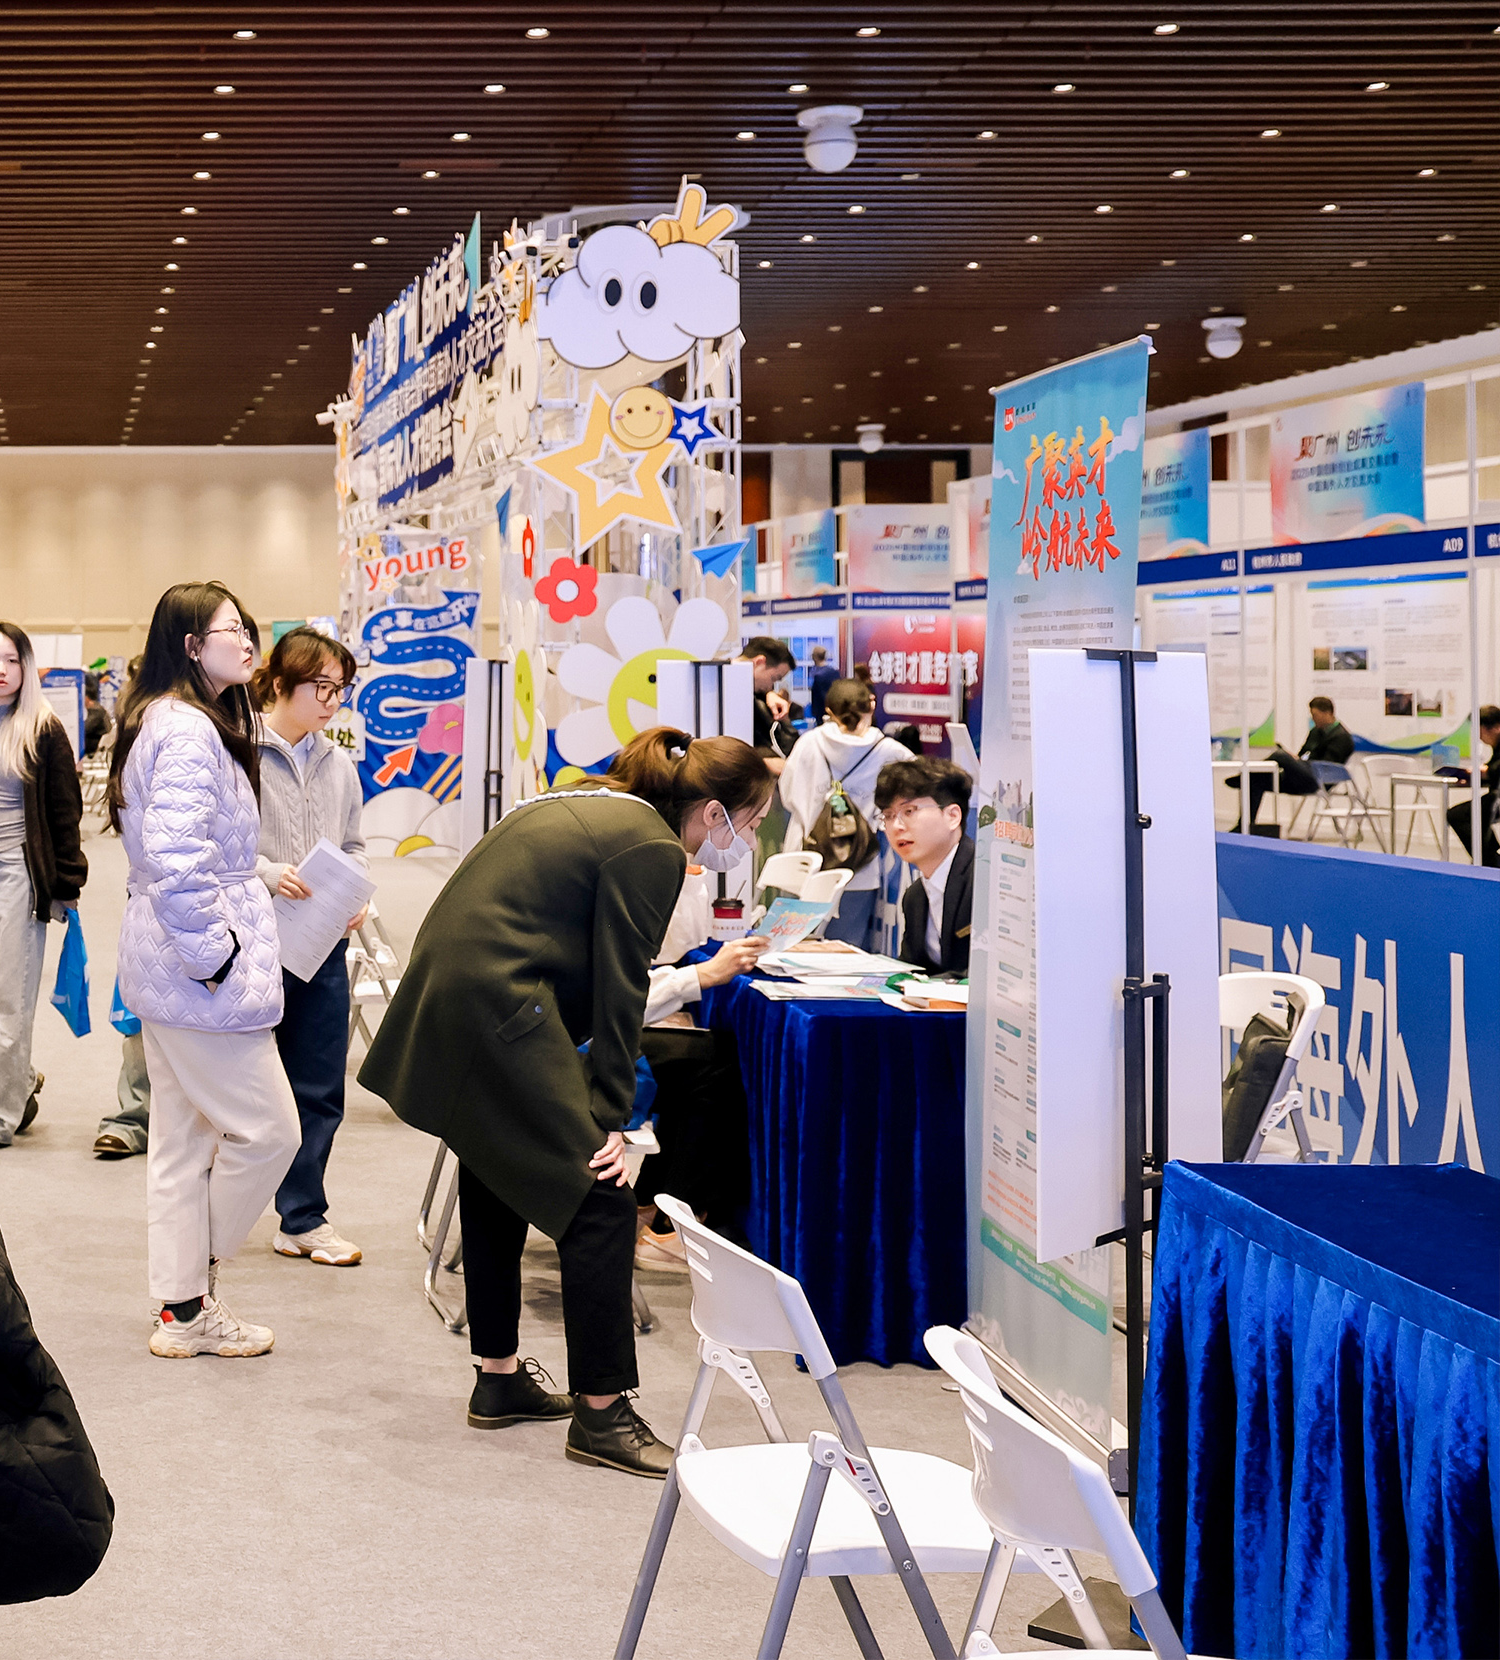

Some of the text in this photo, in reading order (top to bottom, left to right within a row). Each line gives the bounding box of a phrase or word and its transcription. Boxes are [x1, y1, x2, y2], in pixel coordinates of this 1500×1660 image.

[1011, 416, 1115, 530] 广聚英才
[365, 540, 467, 592] young
[1021, 499, 1122, 581] 岭航未来
[868, 650, 979, 687] 全球引才服务家
